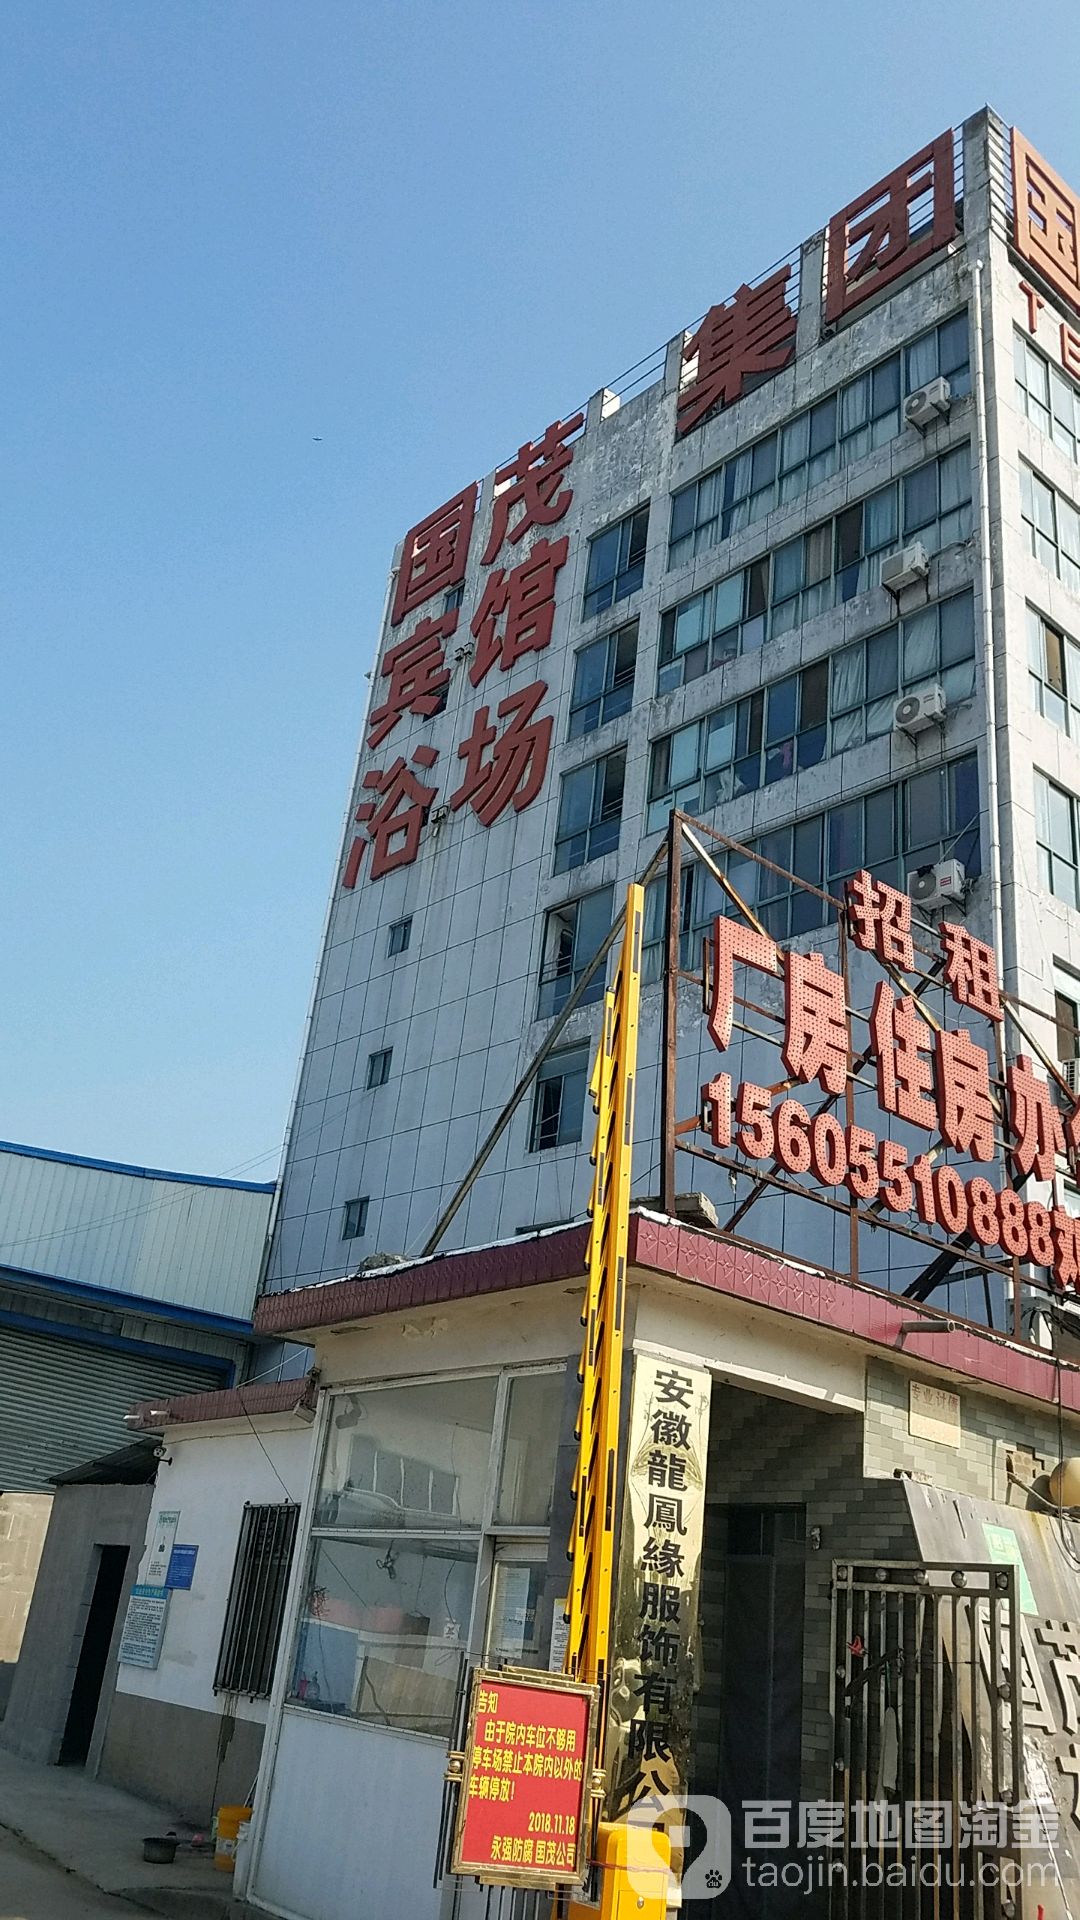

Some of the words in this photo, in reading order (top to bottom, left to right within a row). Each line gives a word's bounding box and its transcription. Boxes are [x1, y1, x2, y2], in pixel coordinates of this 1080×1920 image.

[391, 412, 585, 627] 国茂
[676, 126, 955, 434] 集团
[367, 536, 569, 749] 宾馆
[343, 680, 553, 889] 浴场
[846, 869, 1004, 1023] 招租
[708, 916, 1080, 1181] 厂房住房办
[626, 1369, 694, 1833] 安徽龍鳳緣服饰有限公
[473, 1745, 583, 1782] 停车场禁止本院内以外的
[478, 1690, 498, 1714] 告知
[484, 1719, 576, 1752] 由于院内车位不够用
[491, 1835, 532, 1863] 永强防腐
[535, 1839, 577, 1867] 国茂公司
[528, 1812, 576, 1835] 2018.11.18
